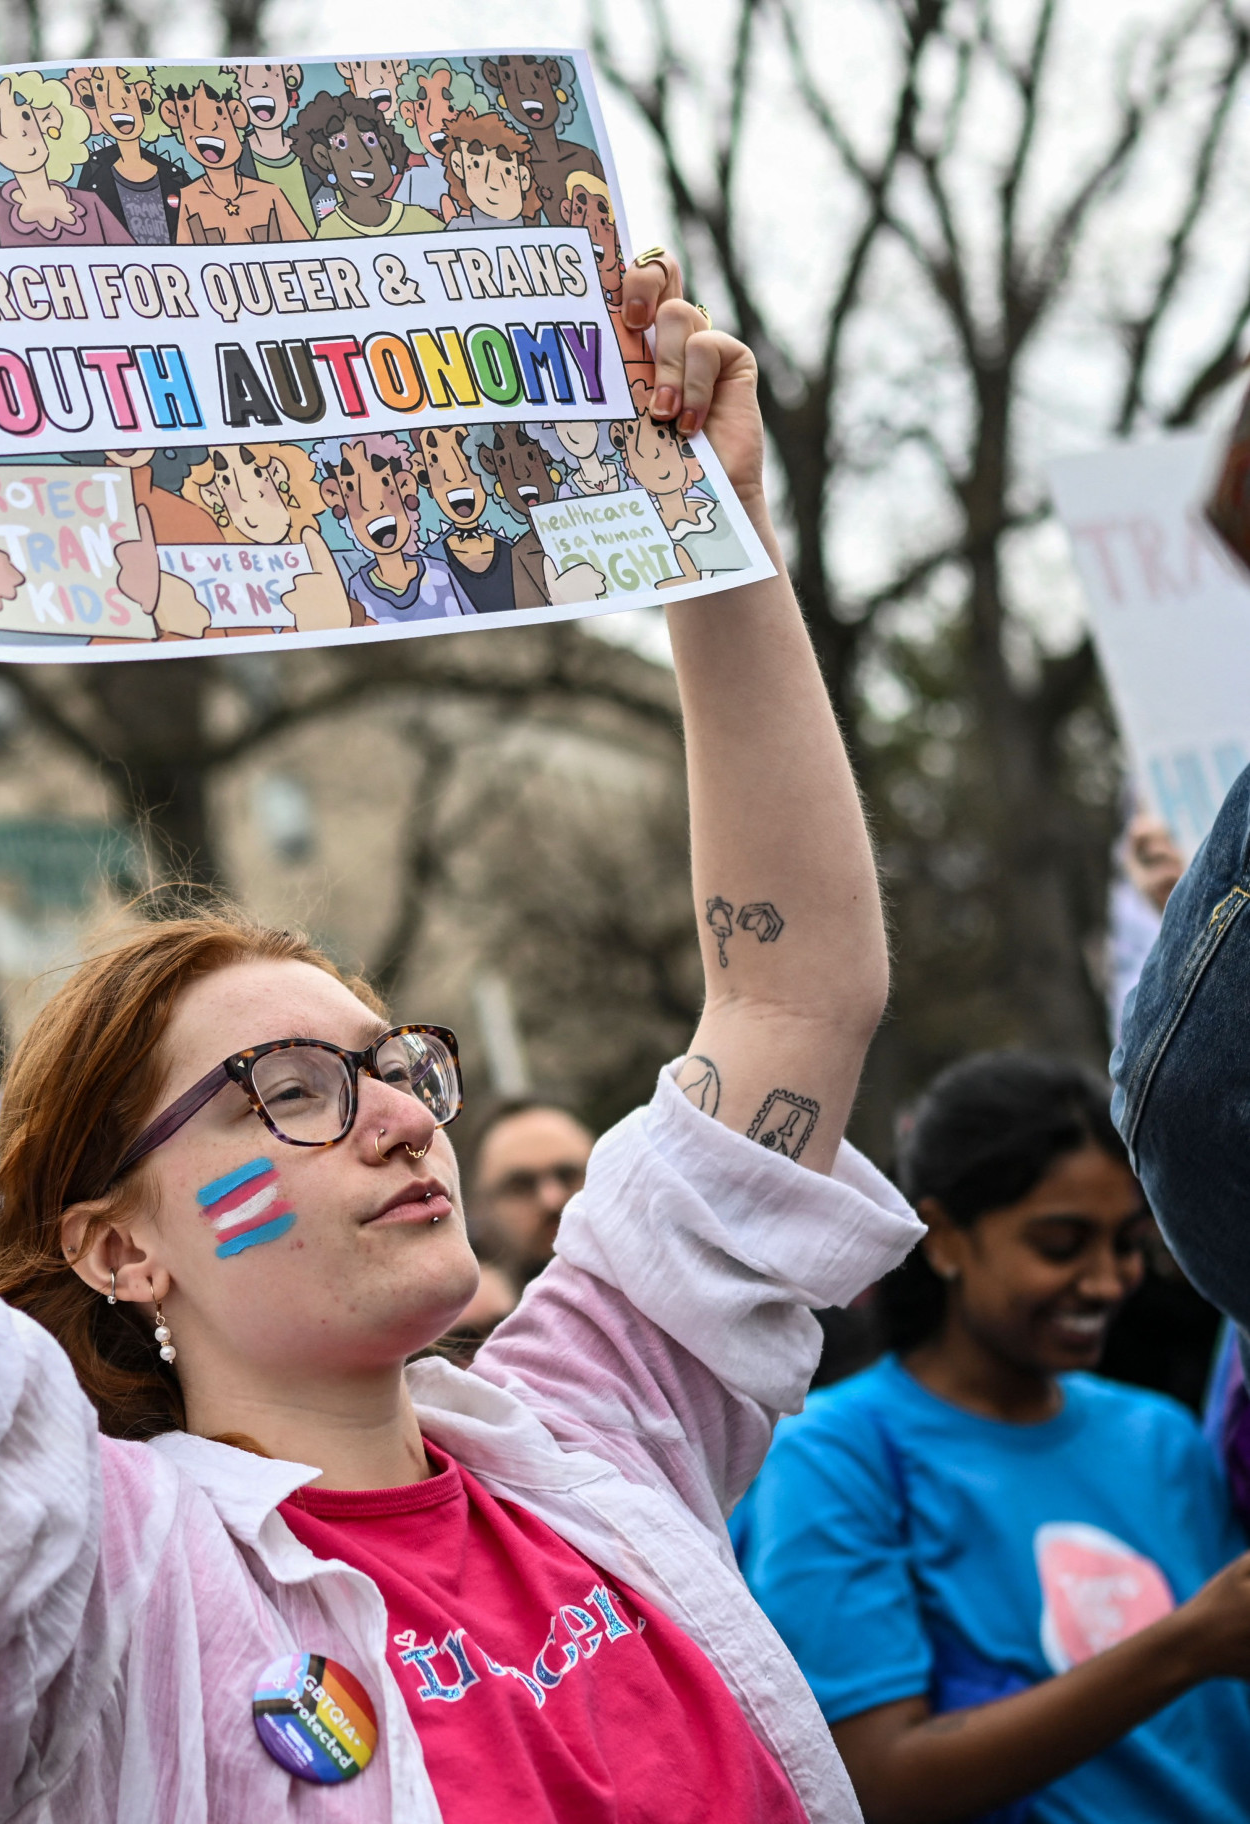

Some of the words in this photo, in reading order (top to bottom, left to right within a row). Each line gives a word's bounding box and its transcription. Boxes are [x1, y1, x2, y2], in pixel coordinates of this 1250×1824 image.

[89, 263, 199, 319] FOR
[201, 257, 370, 323] QUEER
[373, 253, 425, 305] &
[424, 244, 589, 301] TRANS
[215, 322, 607, 428] AUTONOMY
[535, 501, 645, 534] healthcare
[552, 537, 571, 554] is
[573, 535, 588, 548] a
[591, 525, 654, 546] human
[164, 551, 175, 572] I
[180, 551, 233, 573] LOVE
[27, 581, 131, 626] KIDS
[285, 1688, 356, 1769] Protected
